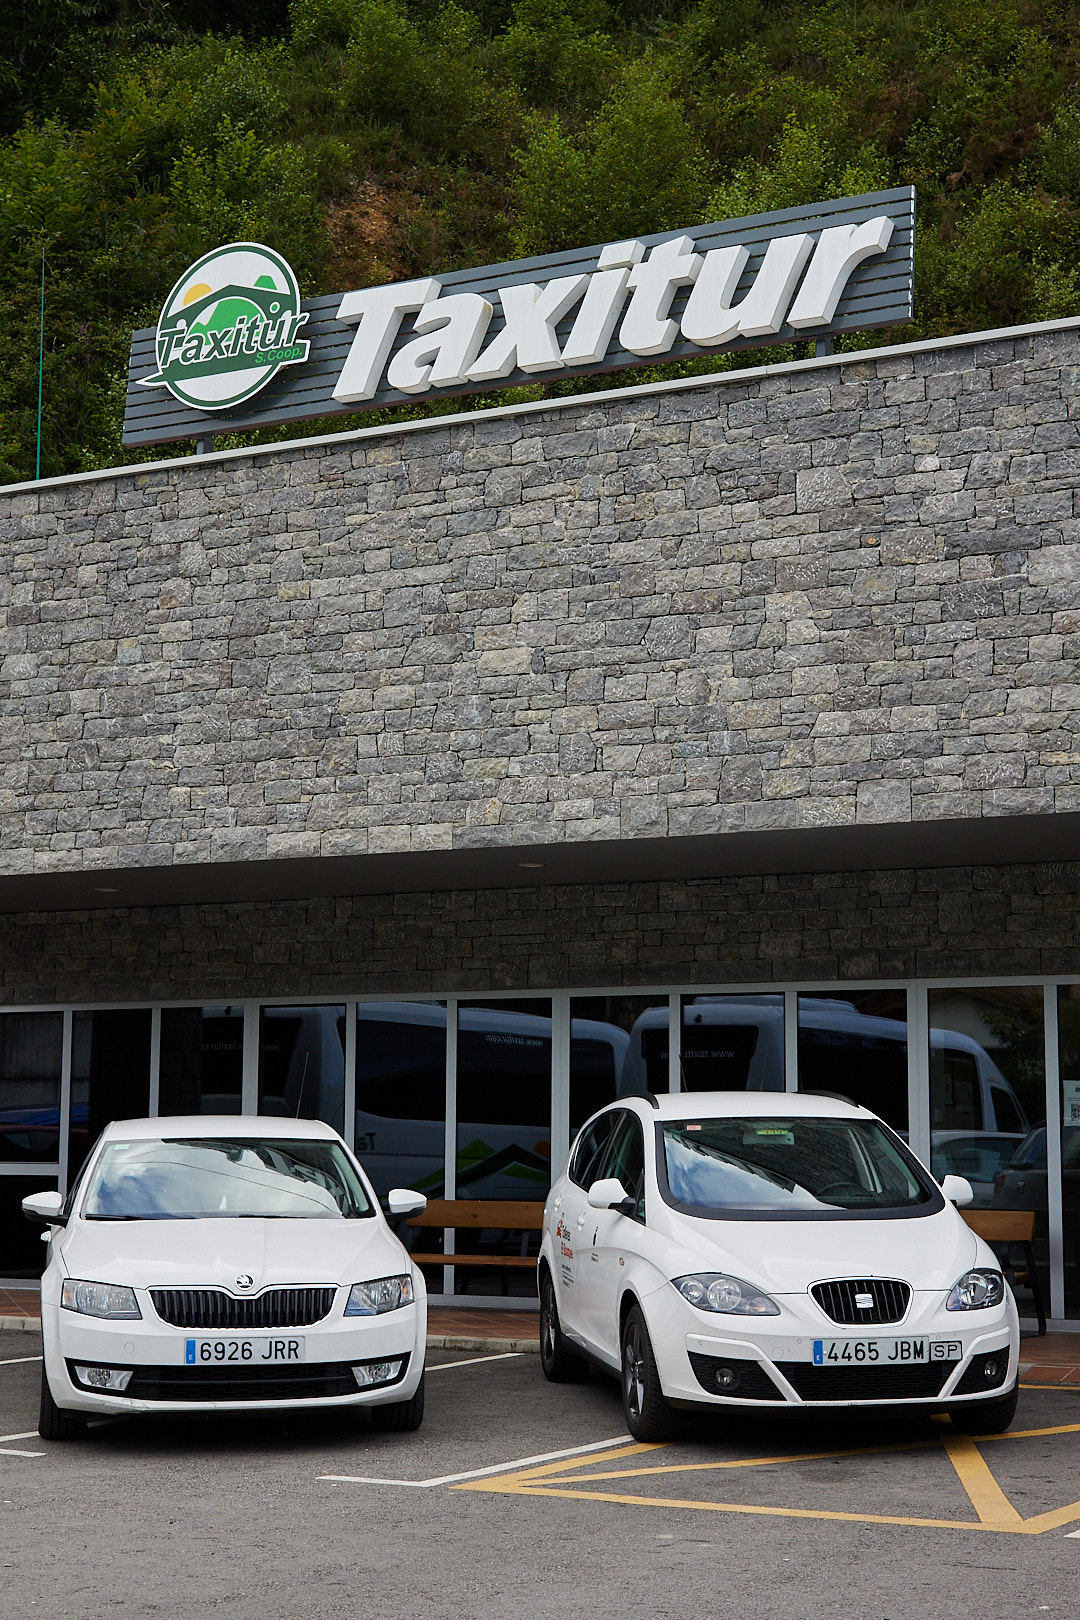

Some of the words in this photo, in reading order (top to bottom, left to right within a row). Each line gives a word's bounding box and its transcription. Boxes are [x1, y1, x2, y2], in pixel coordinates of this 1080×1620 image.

[331, 216, 895, 403] Taxitur
[158, 314, 310, 368] Taxitur
[200, 1341, 253, 1361] 6926
[261, 1340, 300, 1360] JRR
[827, 1342, 880, 1362] 4465
[887, 1340, 925, 1361] JBM
[934, 1344, 958, 1358] SP
